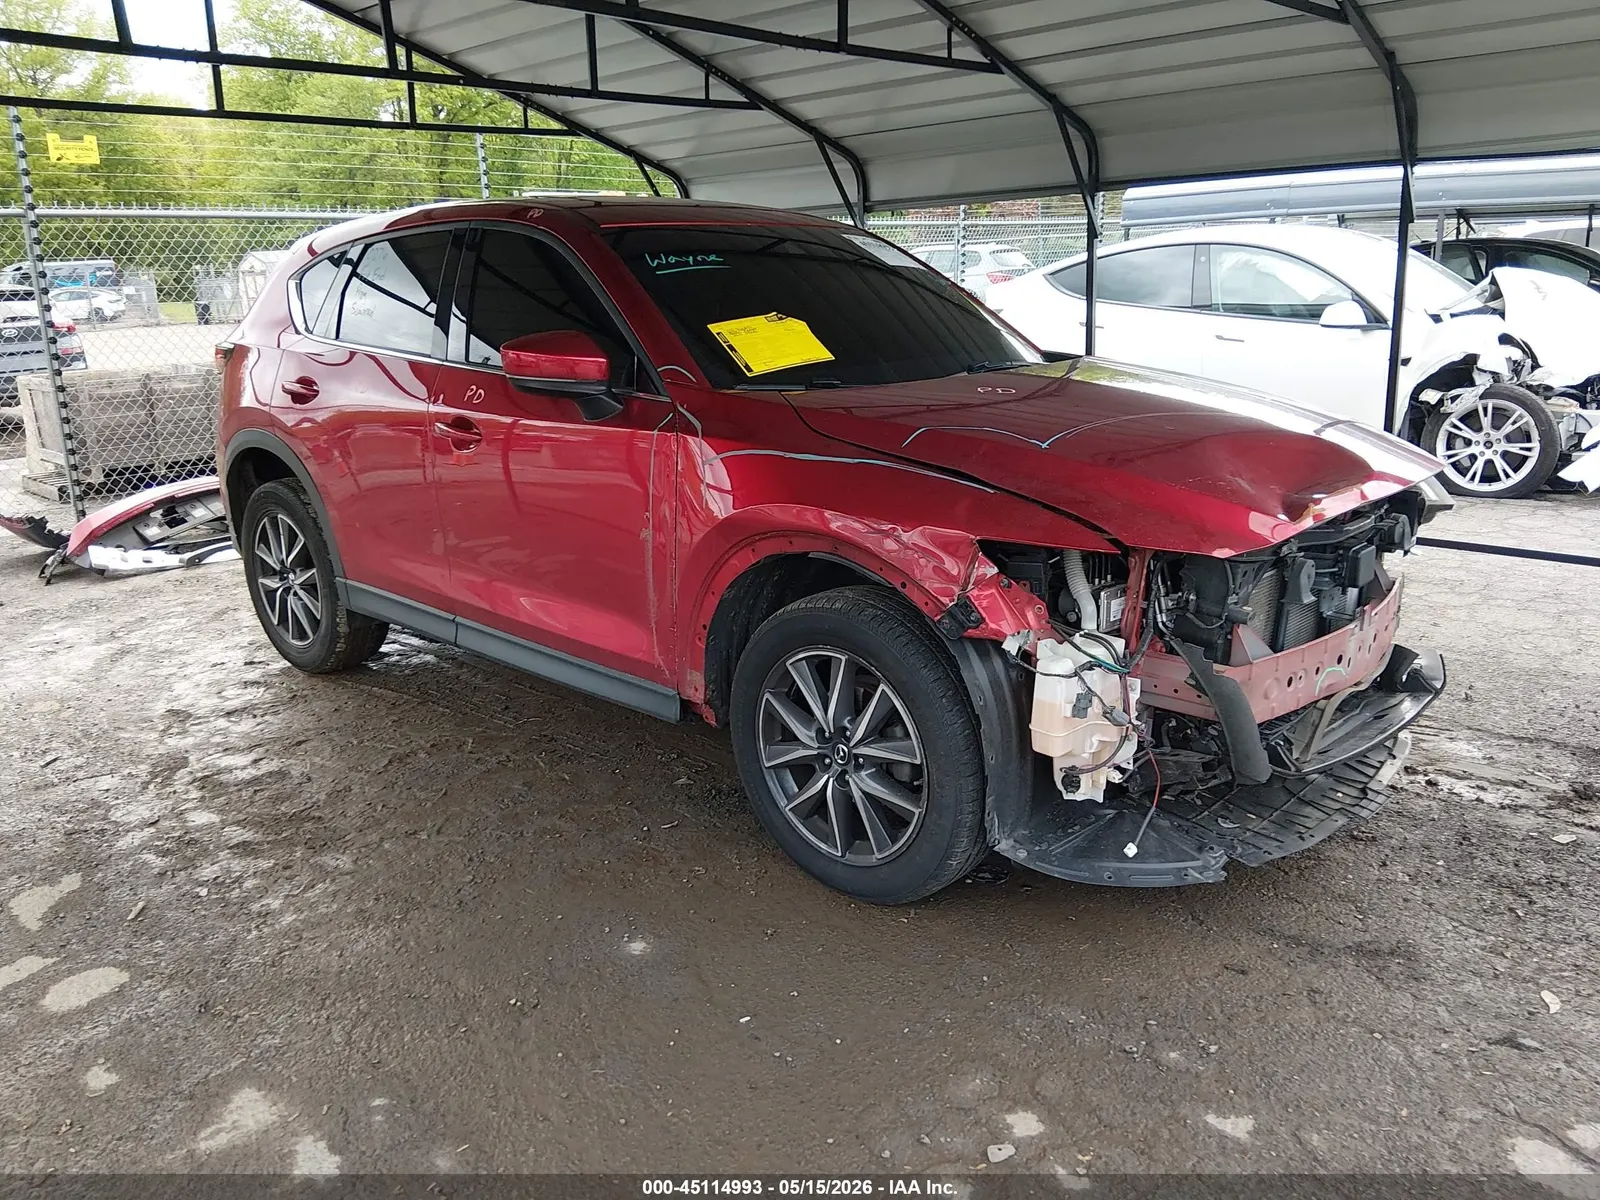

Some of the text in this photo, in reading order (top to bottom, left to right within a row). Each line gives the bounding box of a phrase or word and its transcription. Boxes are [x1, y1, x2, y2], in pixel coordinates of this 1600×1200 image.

[527, 208, 544, 219] PD
[464, 385, 485, 404] PD
[977, 386, 1016, 394] PD
